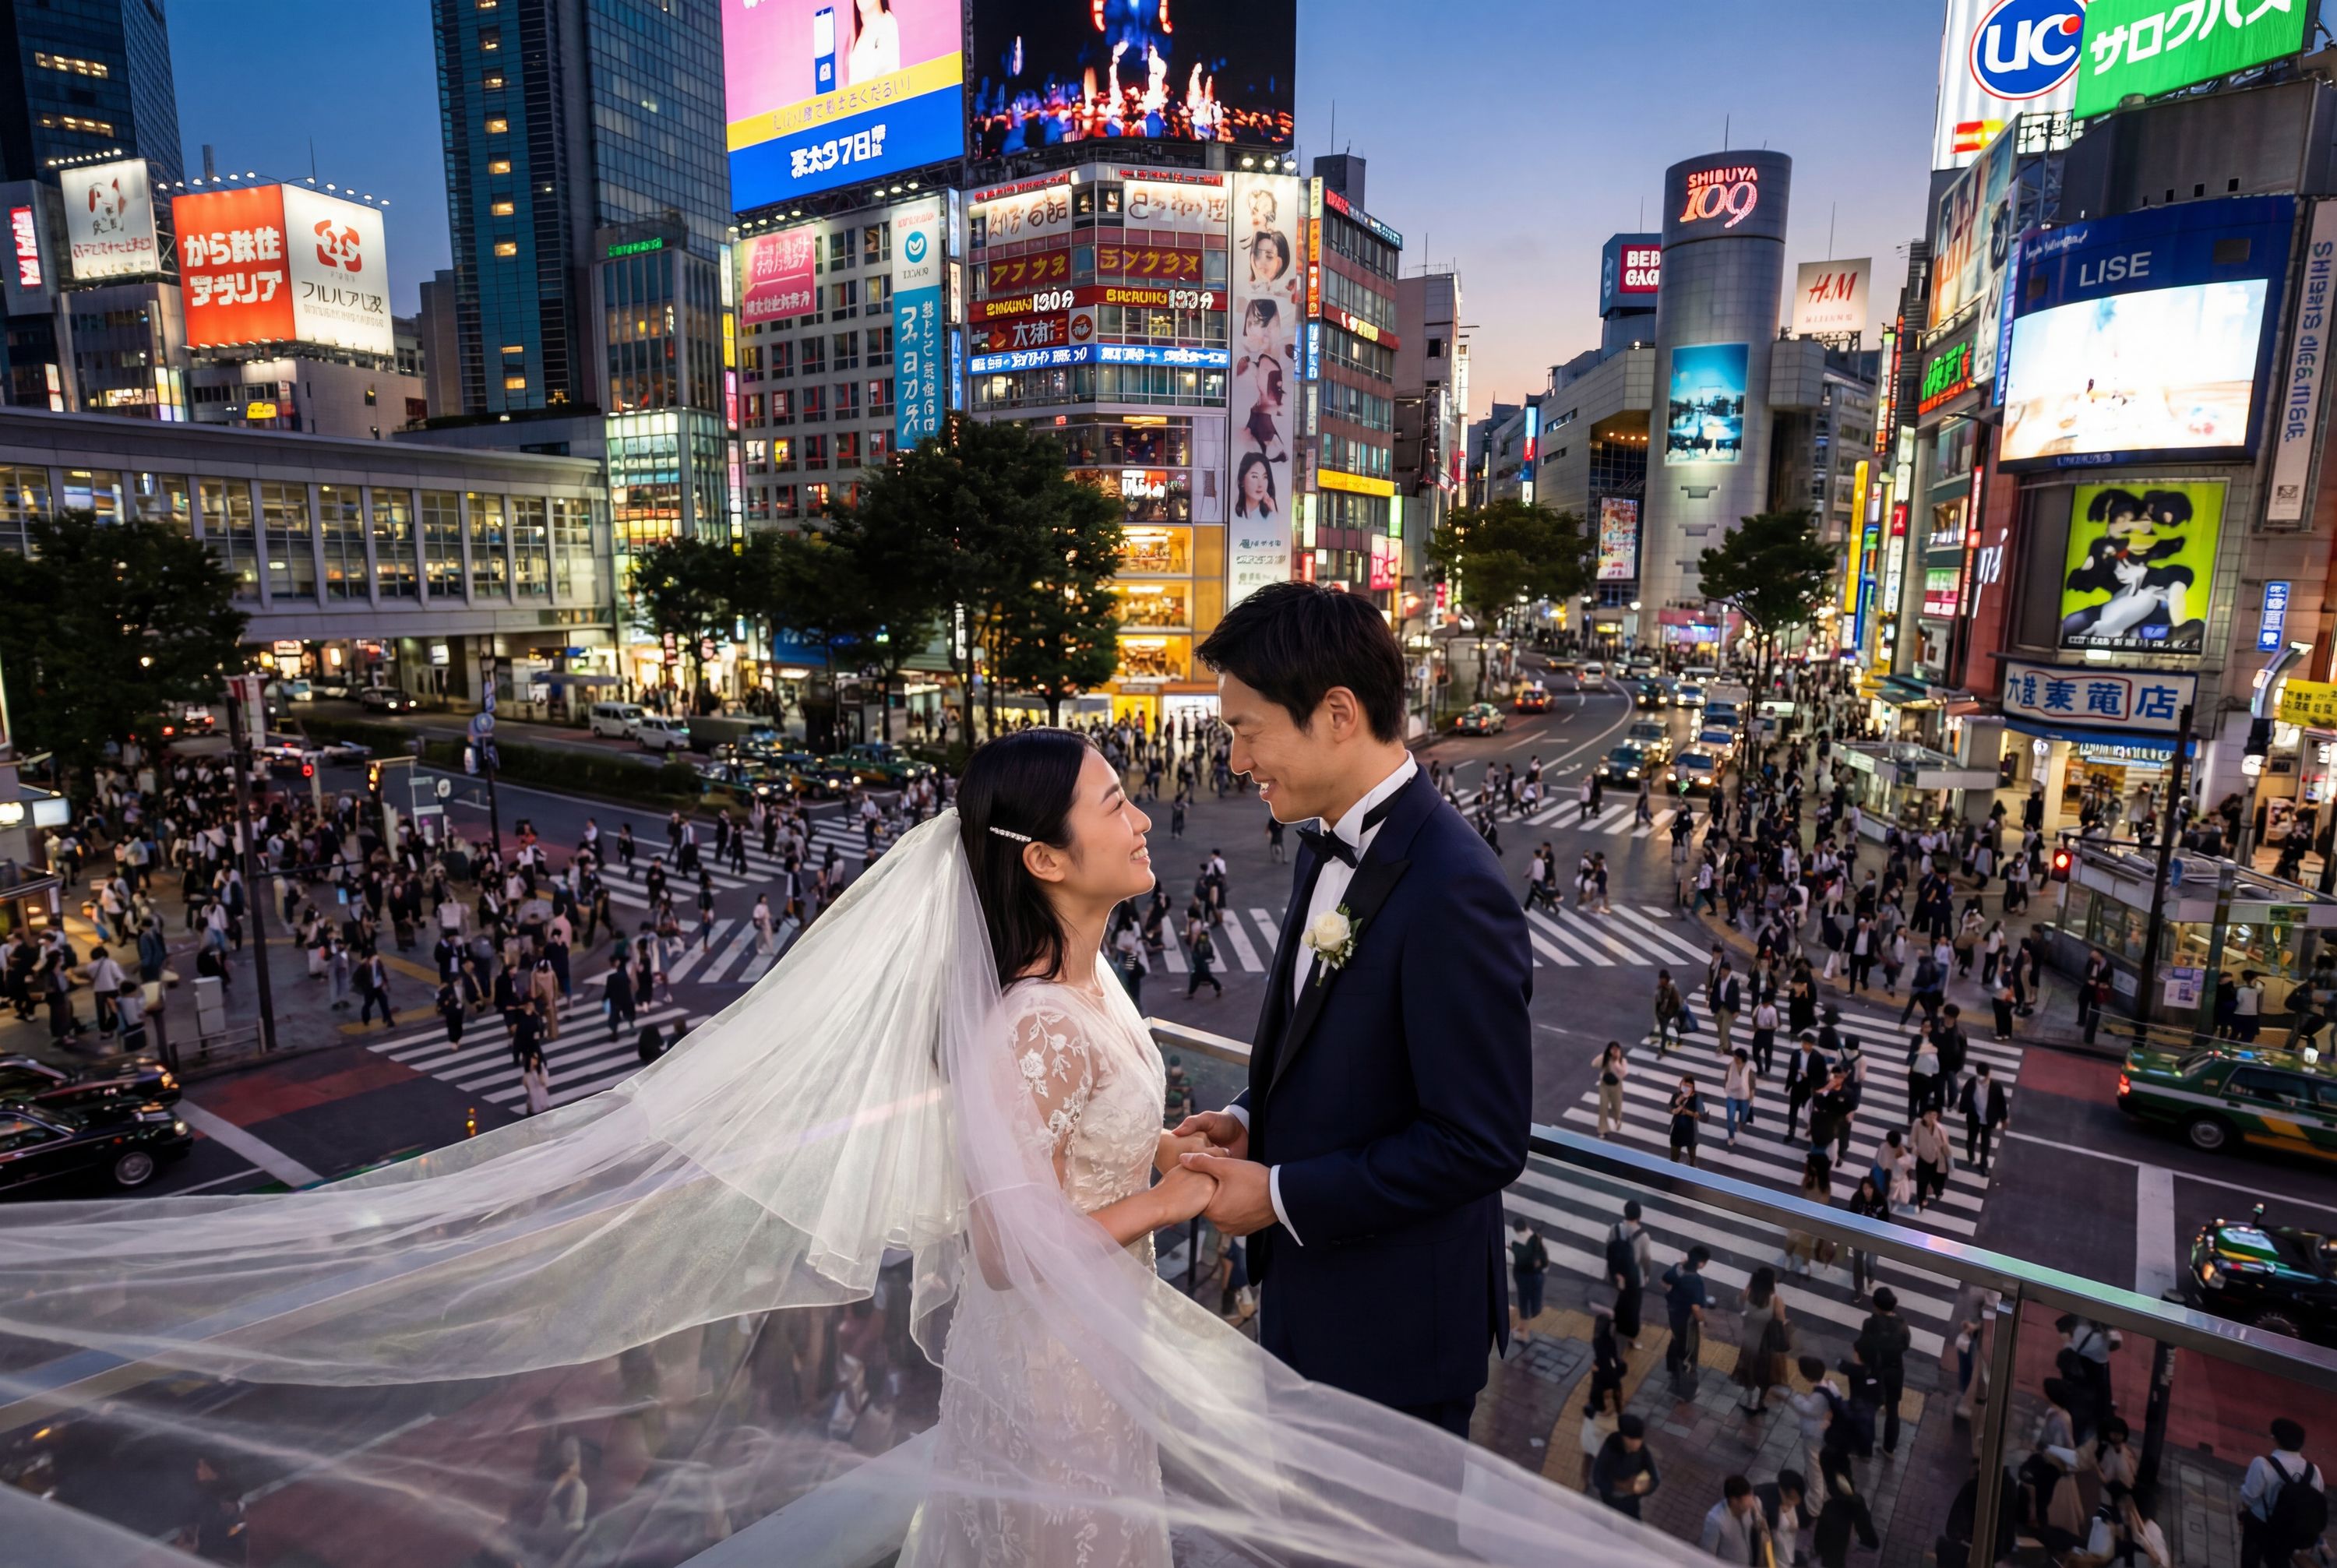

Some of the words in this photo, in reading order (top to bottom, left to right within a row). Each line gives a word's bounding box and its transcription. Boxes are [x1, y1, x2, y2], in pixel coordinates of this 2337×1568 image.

[1689, 167, 1758, 187] SHIBUYA
[1680, 181, 1757, 228] 109
[2079, 251, 2152, 287] LISE
[1808, 271, 1858, 304] H&M
